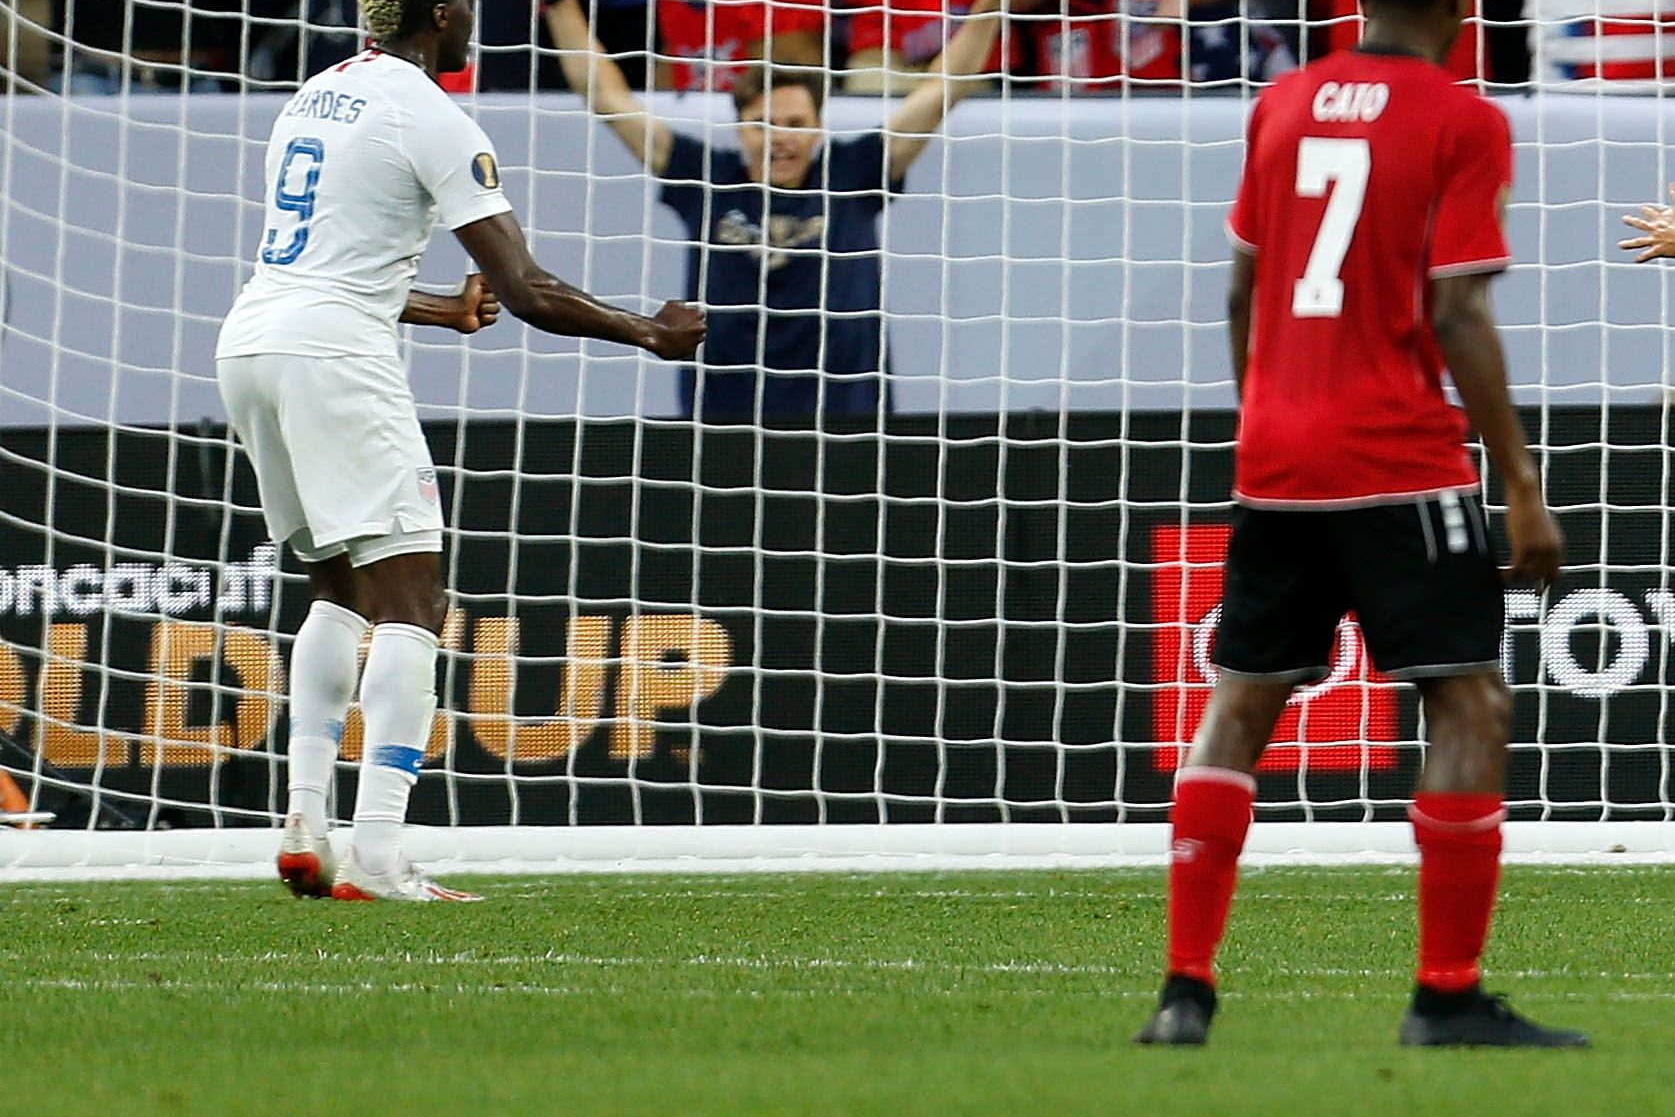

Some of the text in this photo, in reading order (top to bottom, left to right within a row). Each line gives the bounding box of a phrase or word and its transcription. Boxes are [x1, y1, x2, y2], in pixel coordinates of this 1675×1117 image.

[285, 88, 367, 125] ZARDES
[1312, 81, 1390, 123] CATO
[261, 136, 325, 265] 9
[1292, 136, 1371, 318] 7
